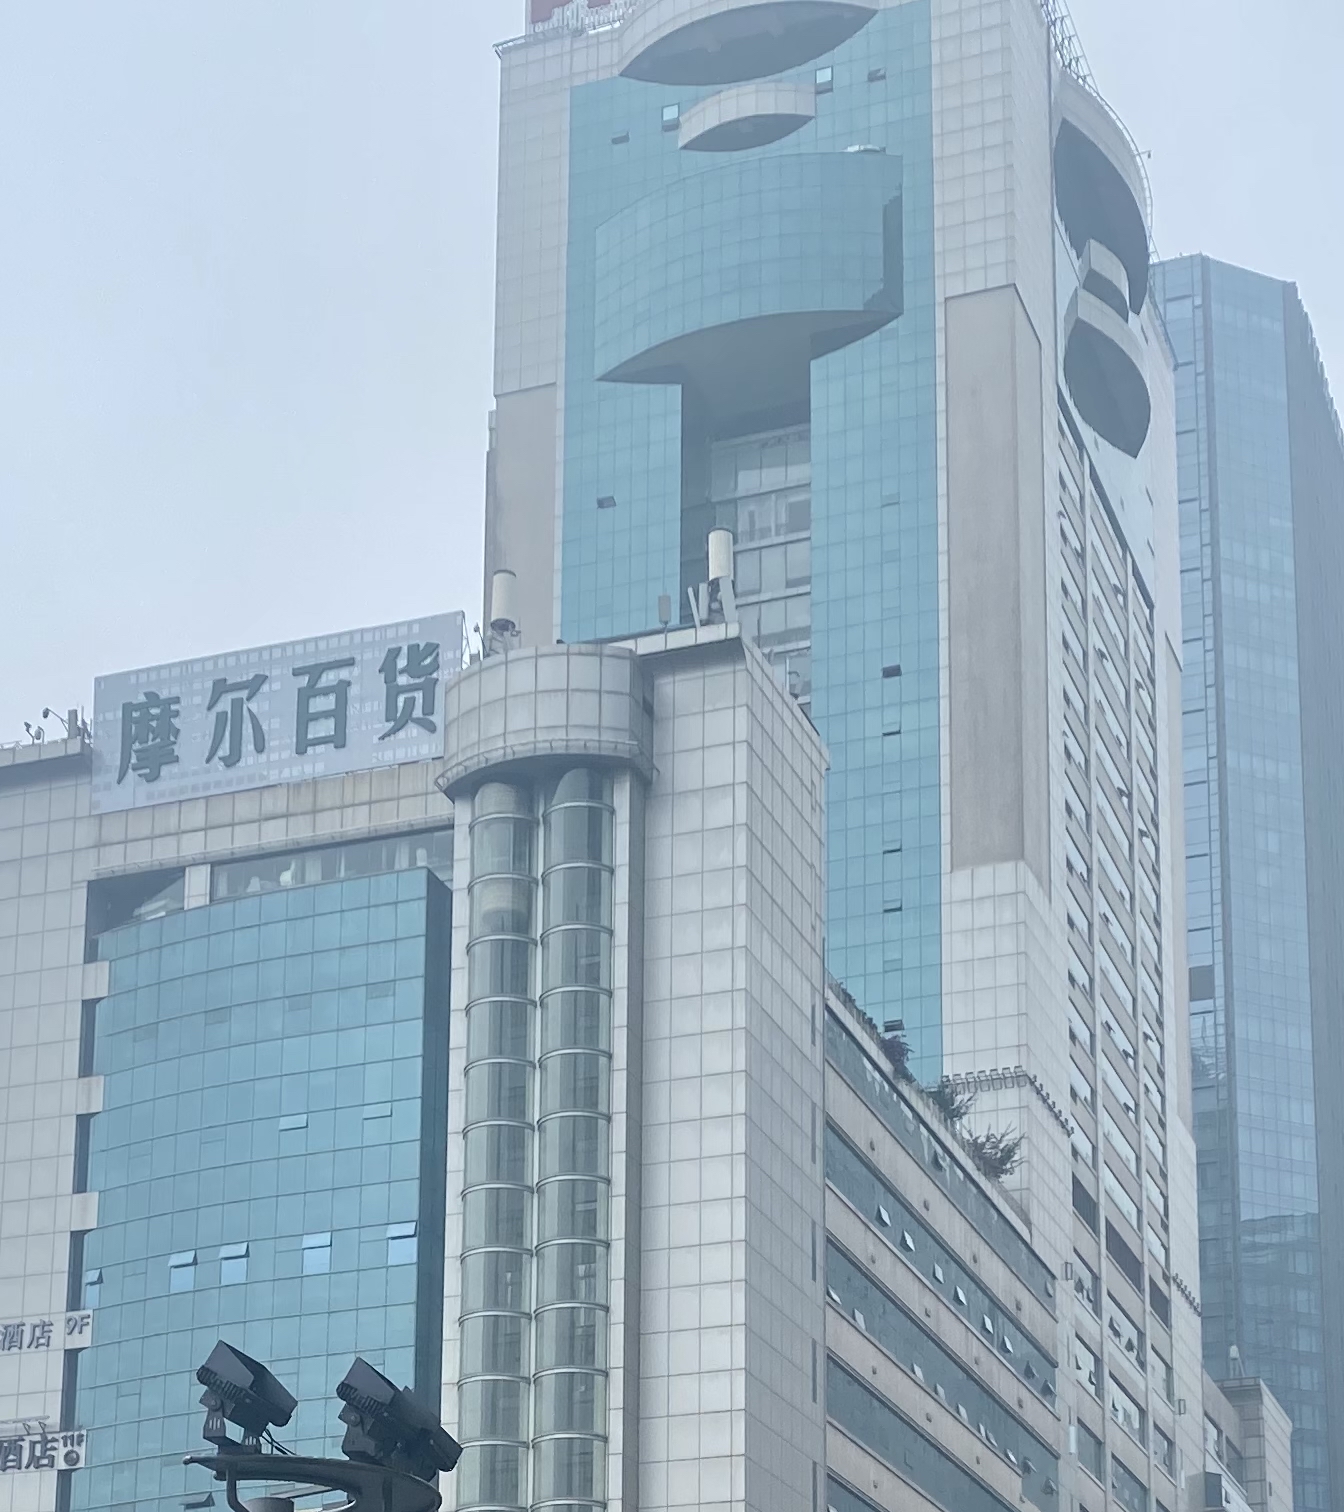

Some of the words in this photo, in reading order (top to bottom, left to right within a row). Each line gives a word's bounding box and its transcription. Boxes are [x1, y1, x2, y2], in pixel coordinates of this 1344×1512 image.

[117, 642, 440, 784] 摩尔百货
[66, 1314, 91, 1335] 9F
